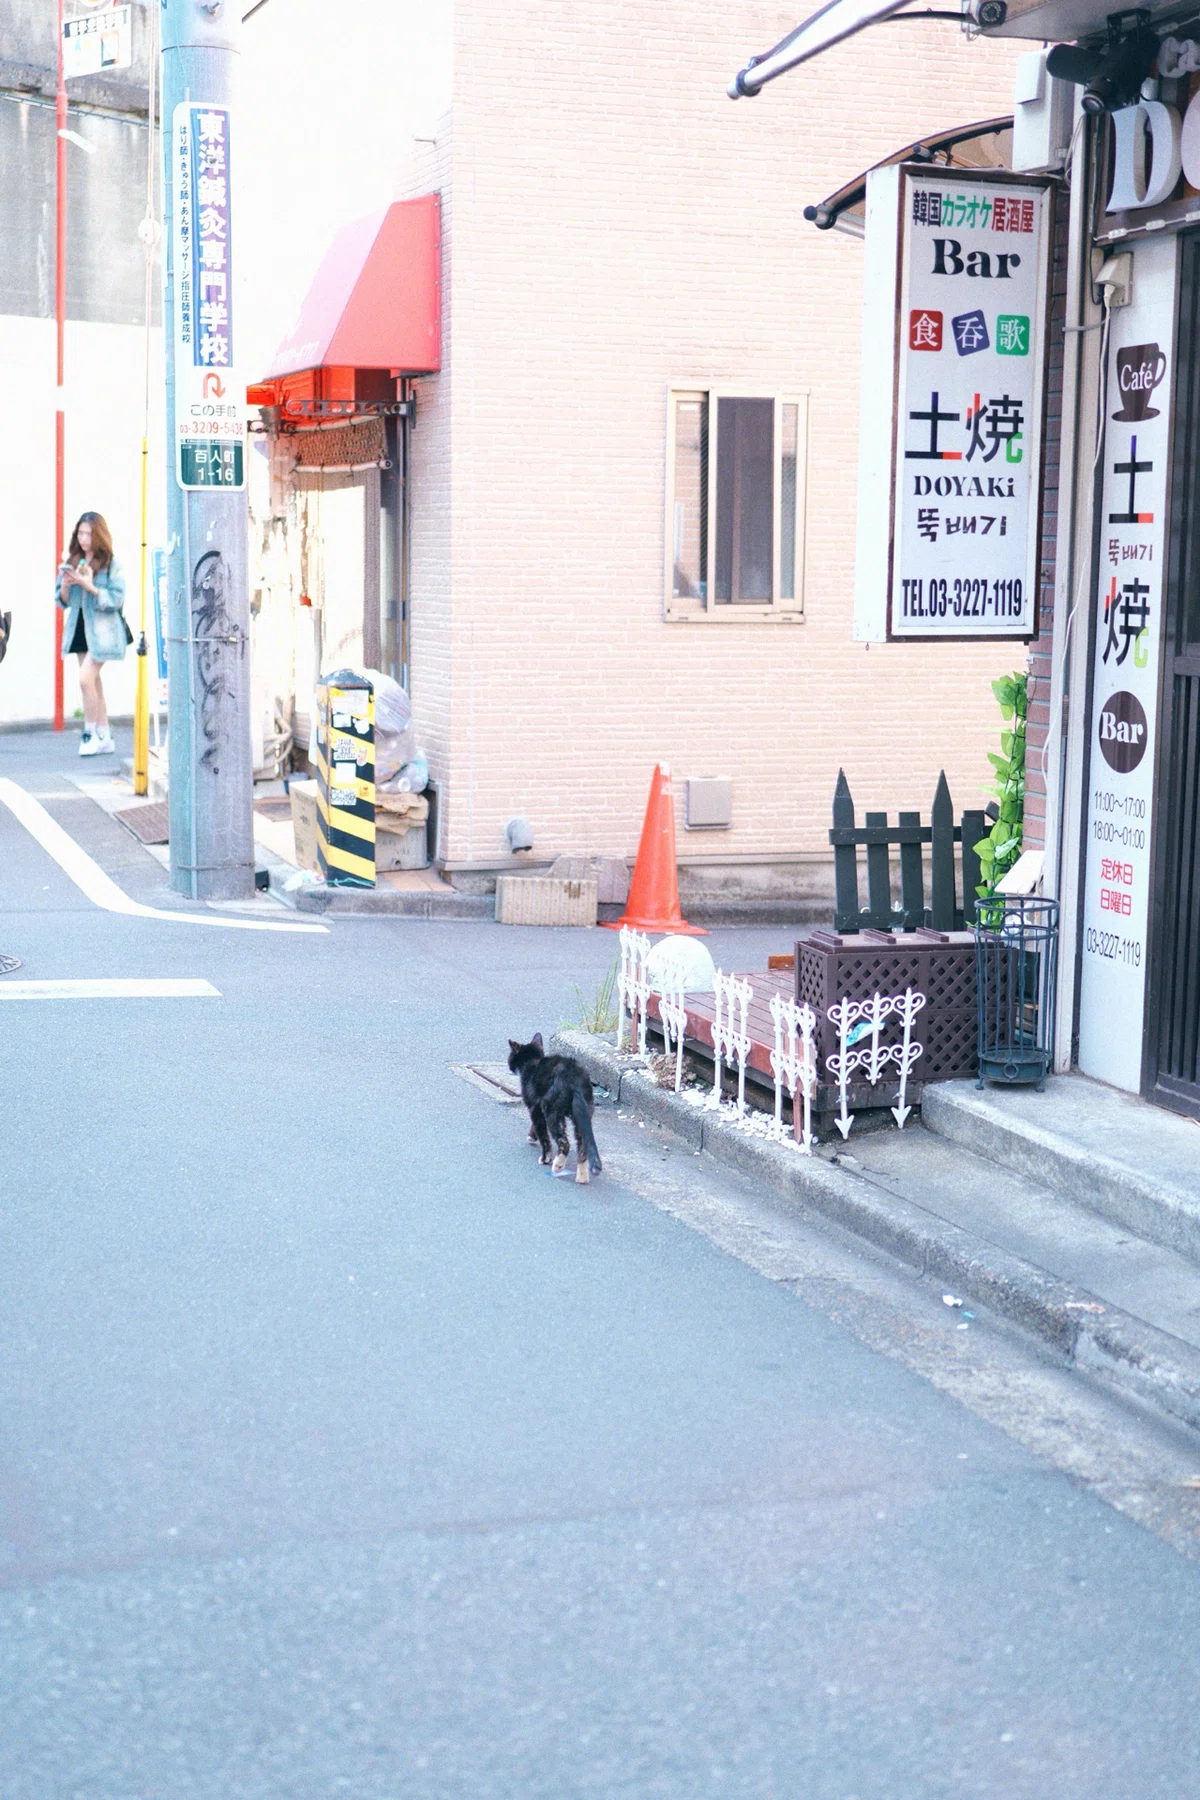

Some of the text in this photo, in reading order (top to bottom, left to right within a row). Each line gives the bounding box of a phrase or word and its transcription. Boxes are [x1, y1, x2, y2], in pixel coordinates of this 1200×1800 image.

[1105, 88, 1200, 212] D
[913, 189, 1034, 233] 韓国カラオケ居酒屋
[197, 112, 228, 364] 東洋鍼灸専門学校
[931, 238, 1021, 279] Bar
[912, 313, 1025, 351] 食 呑 歌
[1120, 361, 1153, 391] Café
[190, 404, 237, 418] この手前
[194, 449, 235, 464] 百人町
[198, 467, 234, 482] 1-16
[916, 508, 1007, 543] 뚝배기
[1108, 538, 1153, 567] 뚝배기
[902, 578, 1023, 618] TEL.03-3227-1119
[1101, 711, 1144, 744] Bar
[1100, 857, 1134, 886] 定休日
[1100, 888, 1132, 917] 日曜日
[1086, 927, 1142, 967] 03-3227-1119
